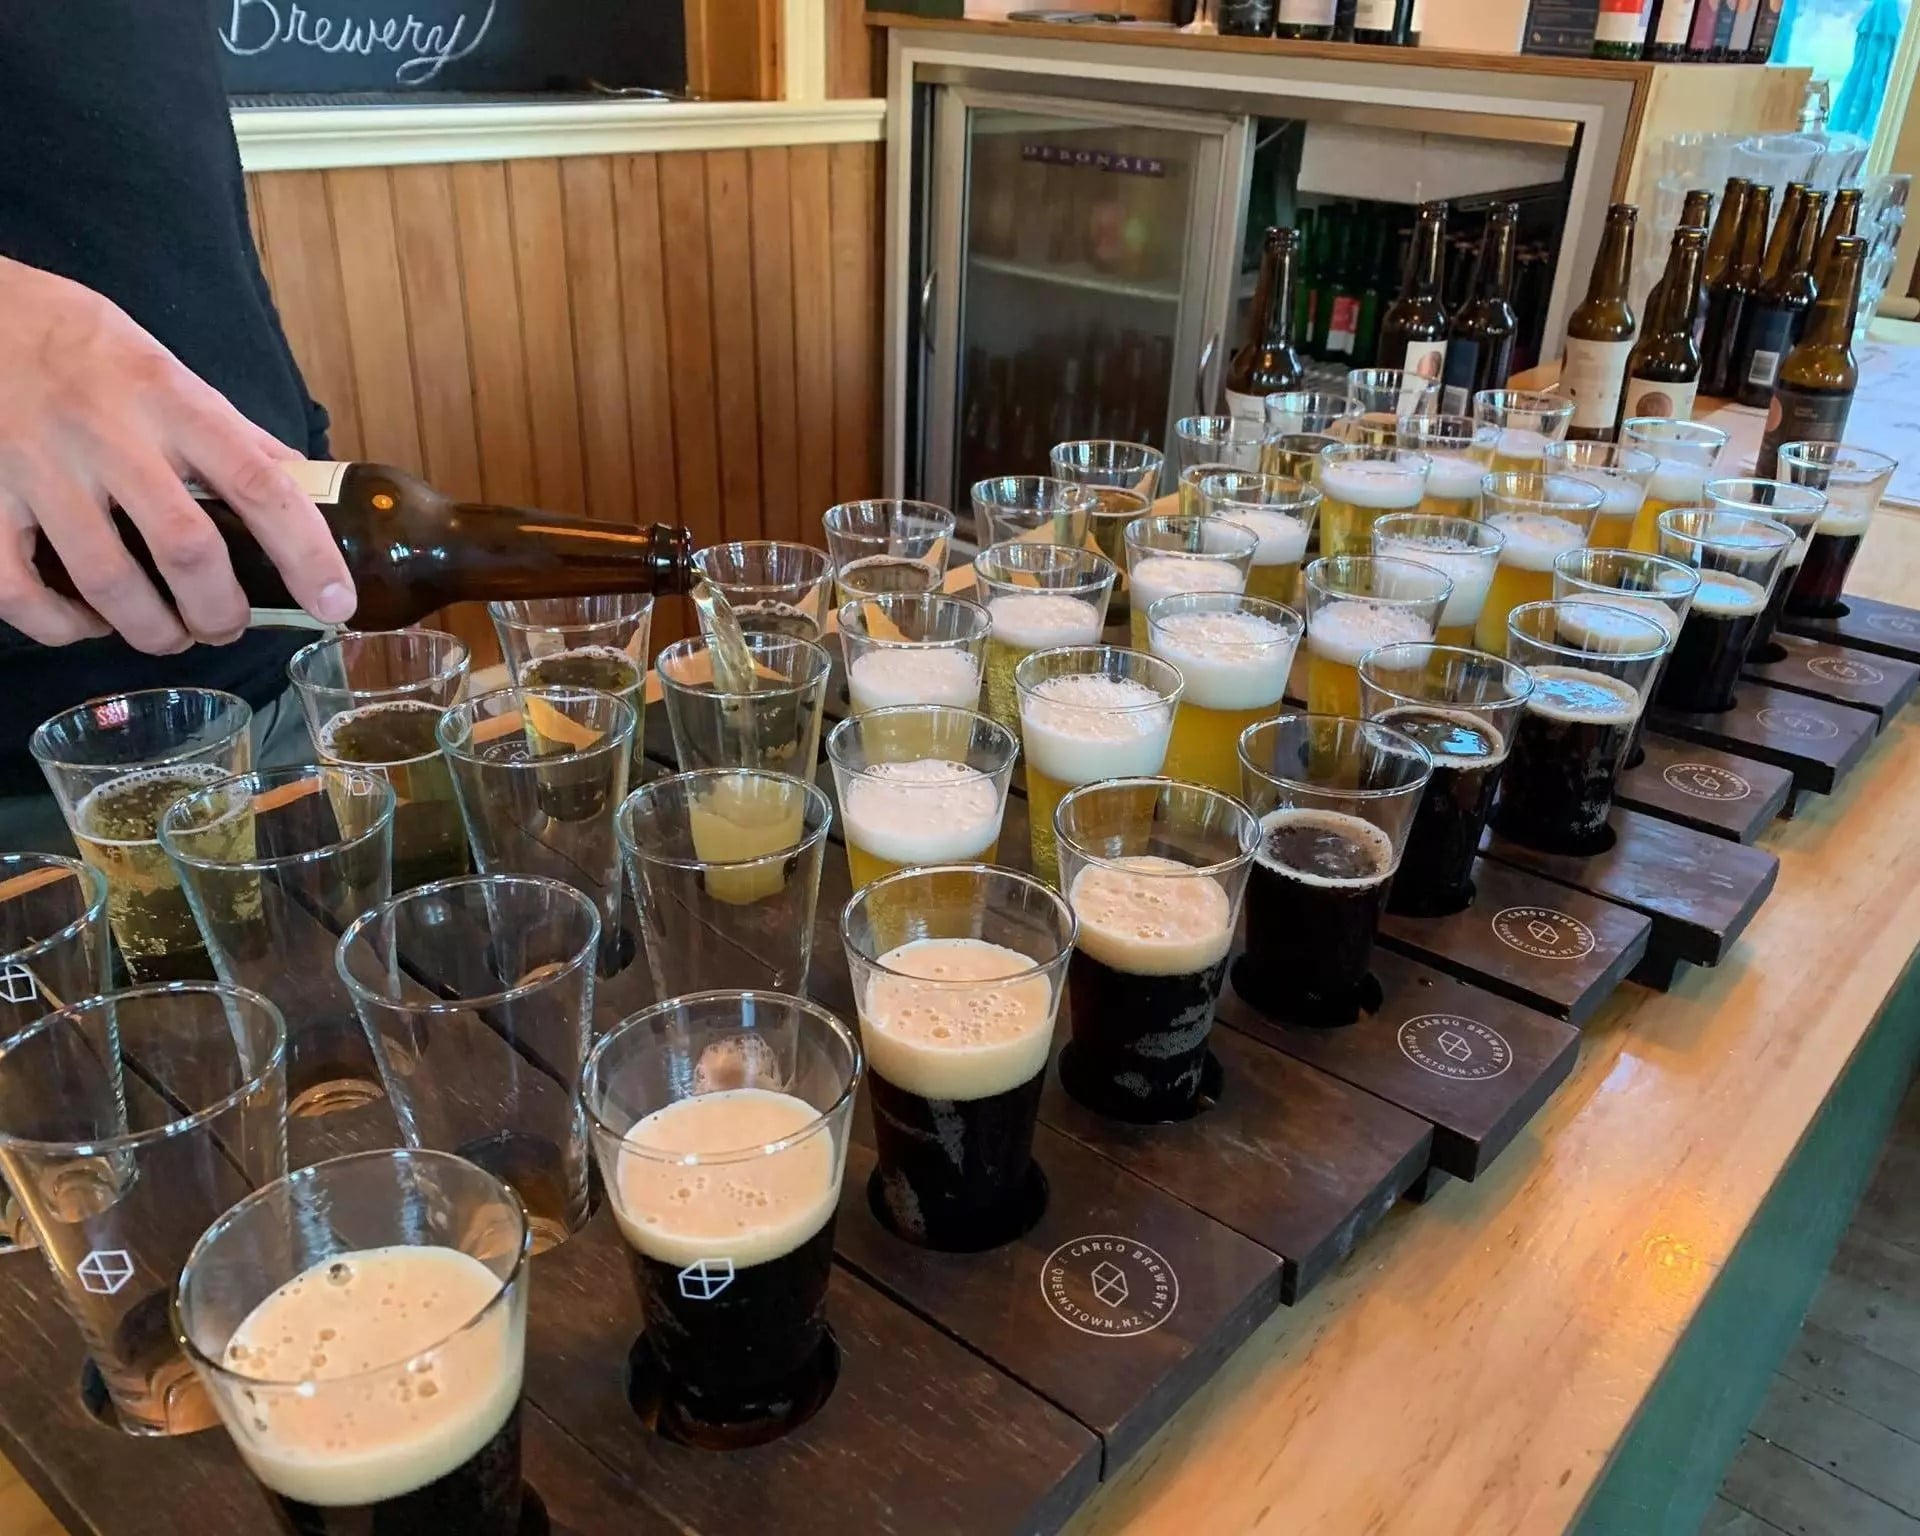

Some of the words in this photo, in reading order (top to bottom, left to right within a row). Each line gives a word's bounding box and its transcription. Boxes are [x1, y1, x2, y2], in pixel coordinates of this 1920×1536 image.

[218, 0, 493, 85] Brewery
[1416, 1018, 1461, 1030] CARGO
[1070, 1241, 1126, 1257] CARGO
[1131, 1249, 1169, 1310] BREWERY
